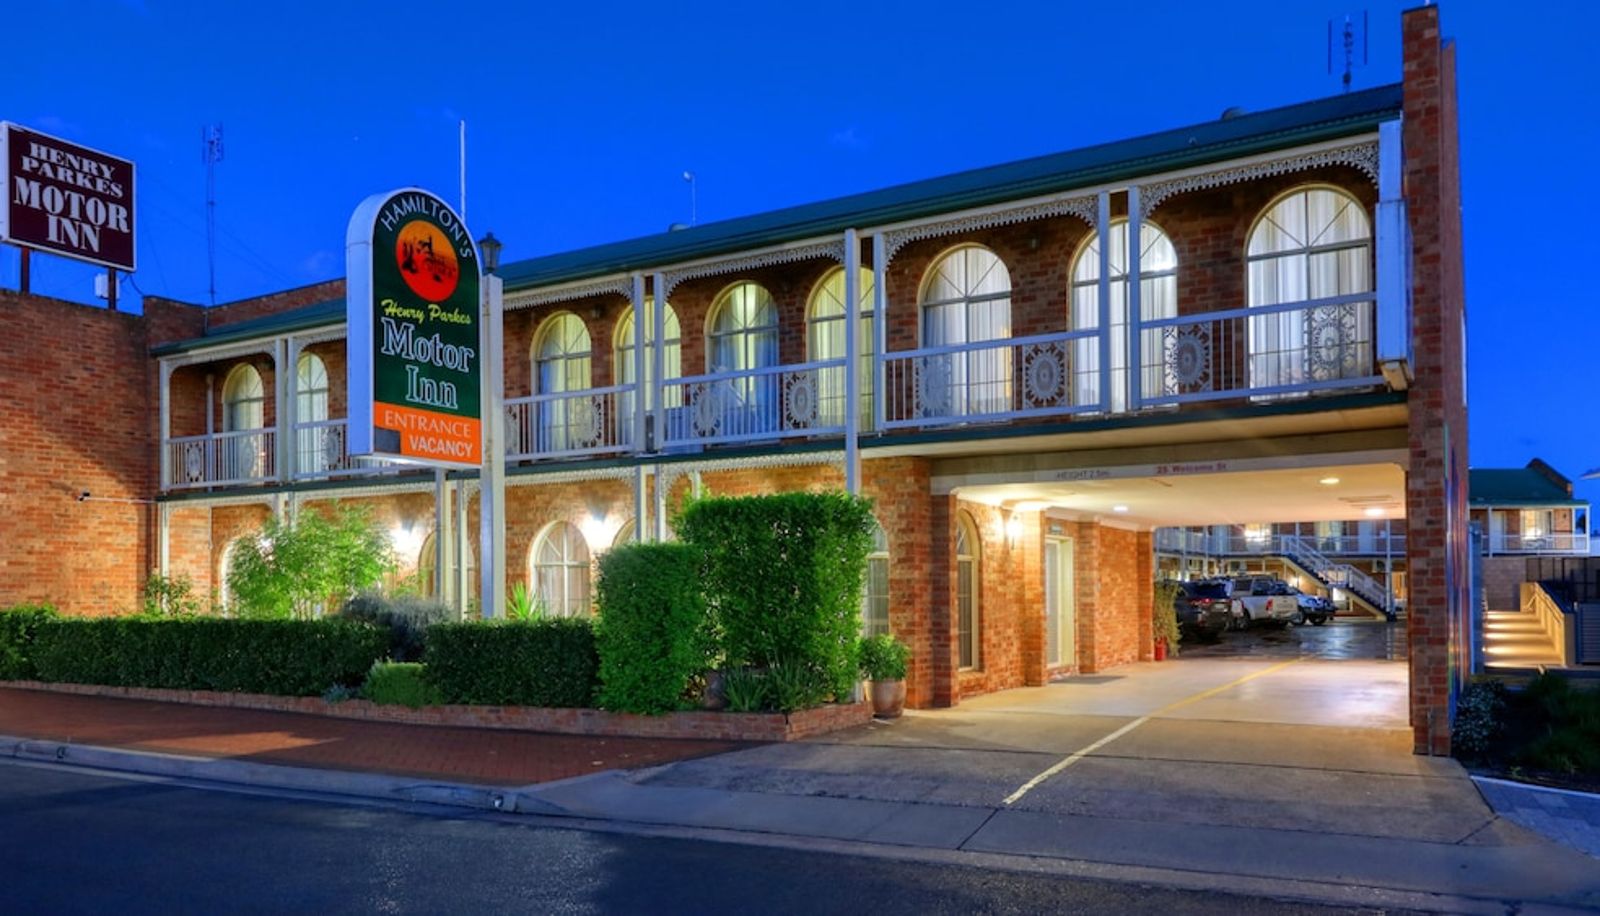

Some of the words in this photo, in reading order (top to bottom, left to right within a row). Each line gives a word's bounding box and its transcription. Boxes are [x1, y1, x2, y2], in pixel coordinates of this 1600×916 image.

[22, 156, 123, 198] PARKES
[30, 143, 115, 179] HENRY
[14, 176, 130, 233] MOTOR
[47, 214, 101, 252] INN
[380, 195, 473, 259] HAMILTON'S
[380, 299, 426, 324] Henry
[427, 303, 472, 325] Parkes
[381, 317, 474, 372] Motor
[405, 365, 458, 409] Inn
[384, 410, 473, 439] ENTRANCE
[409, 434, 474, 459] VACANCY
[1056, 470, 1088, 481] HEIGHT
[1172, 463, 1214, 474] Welcome
